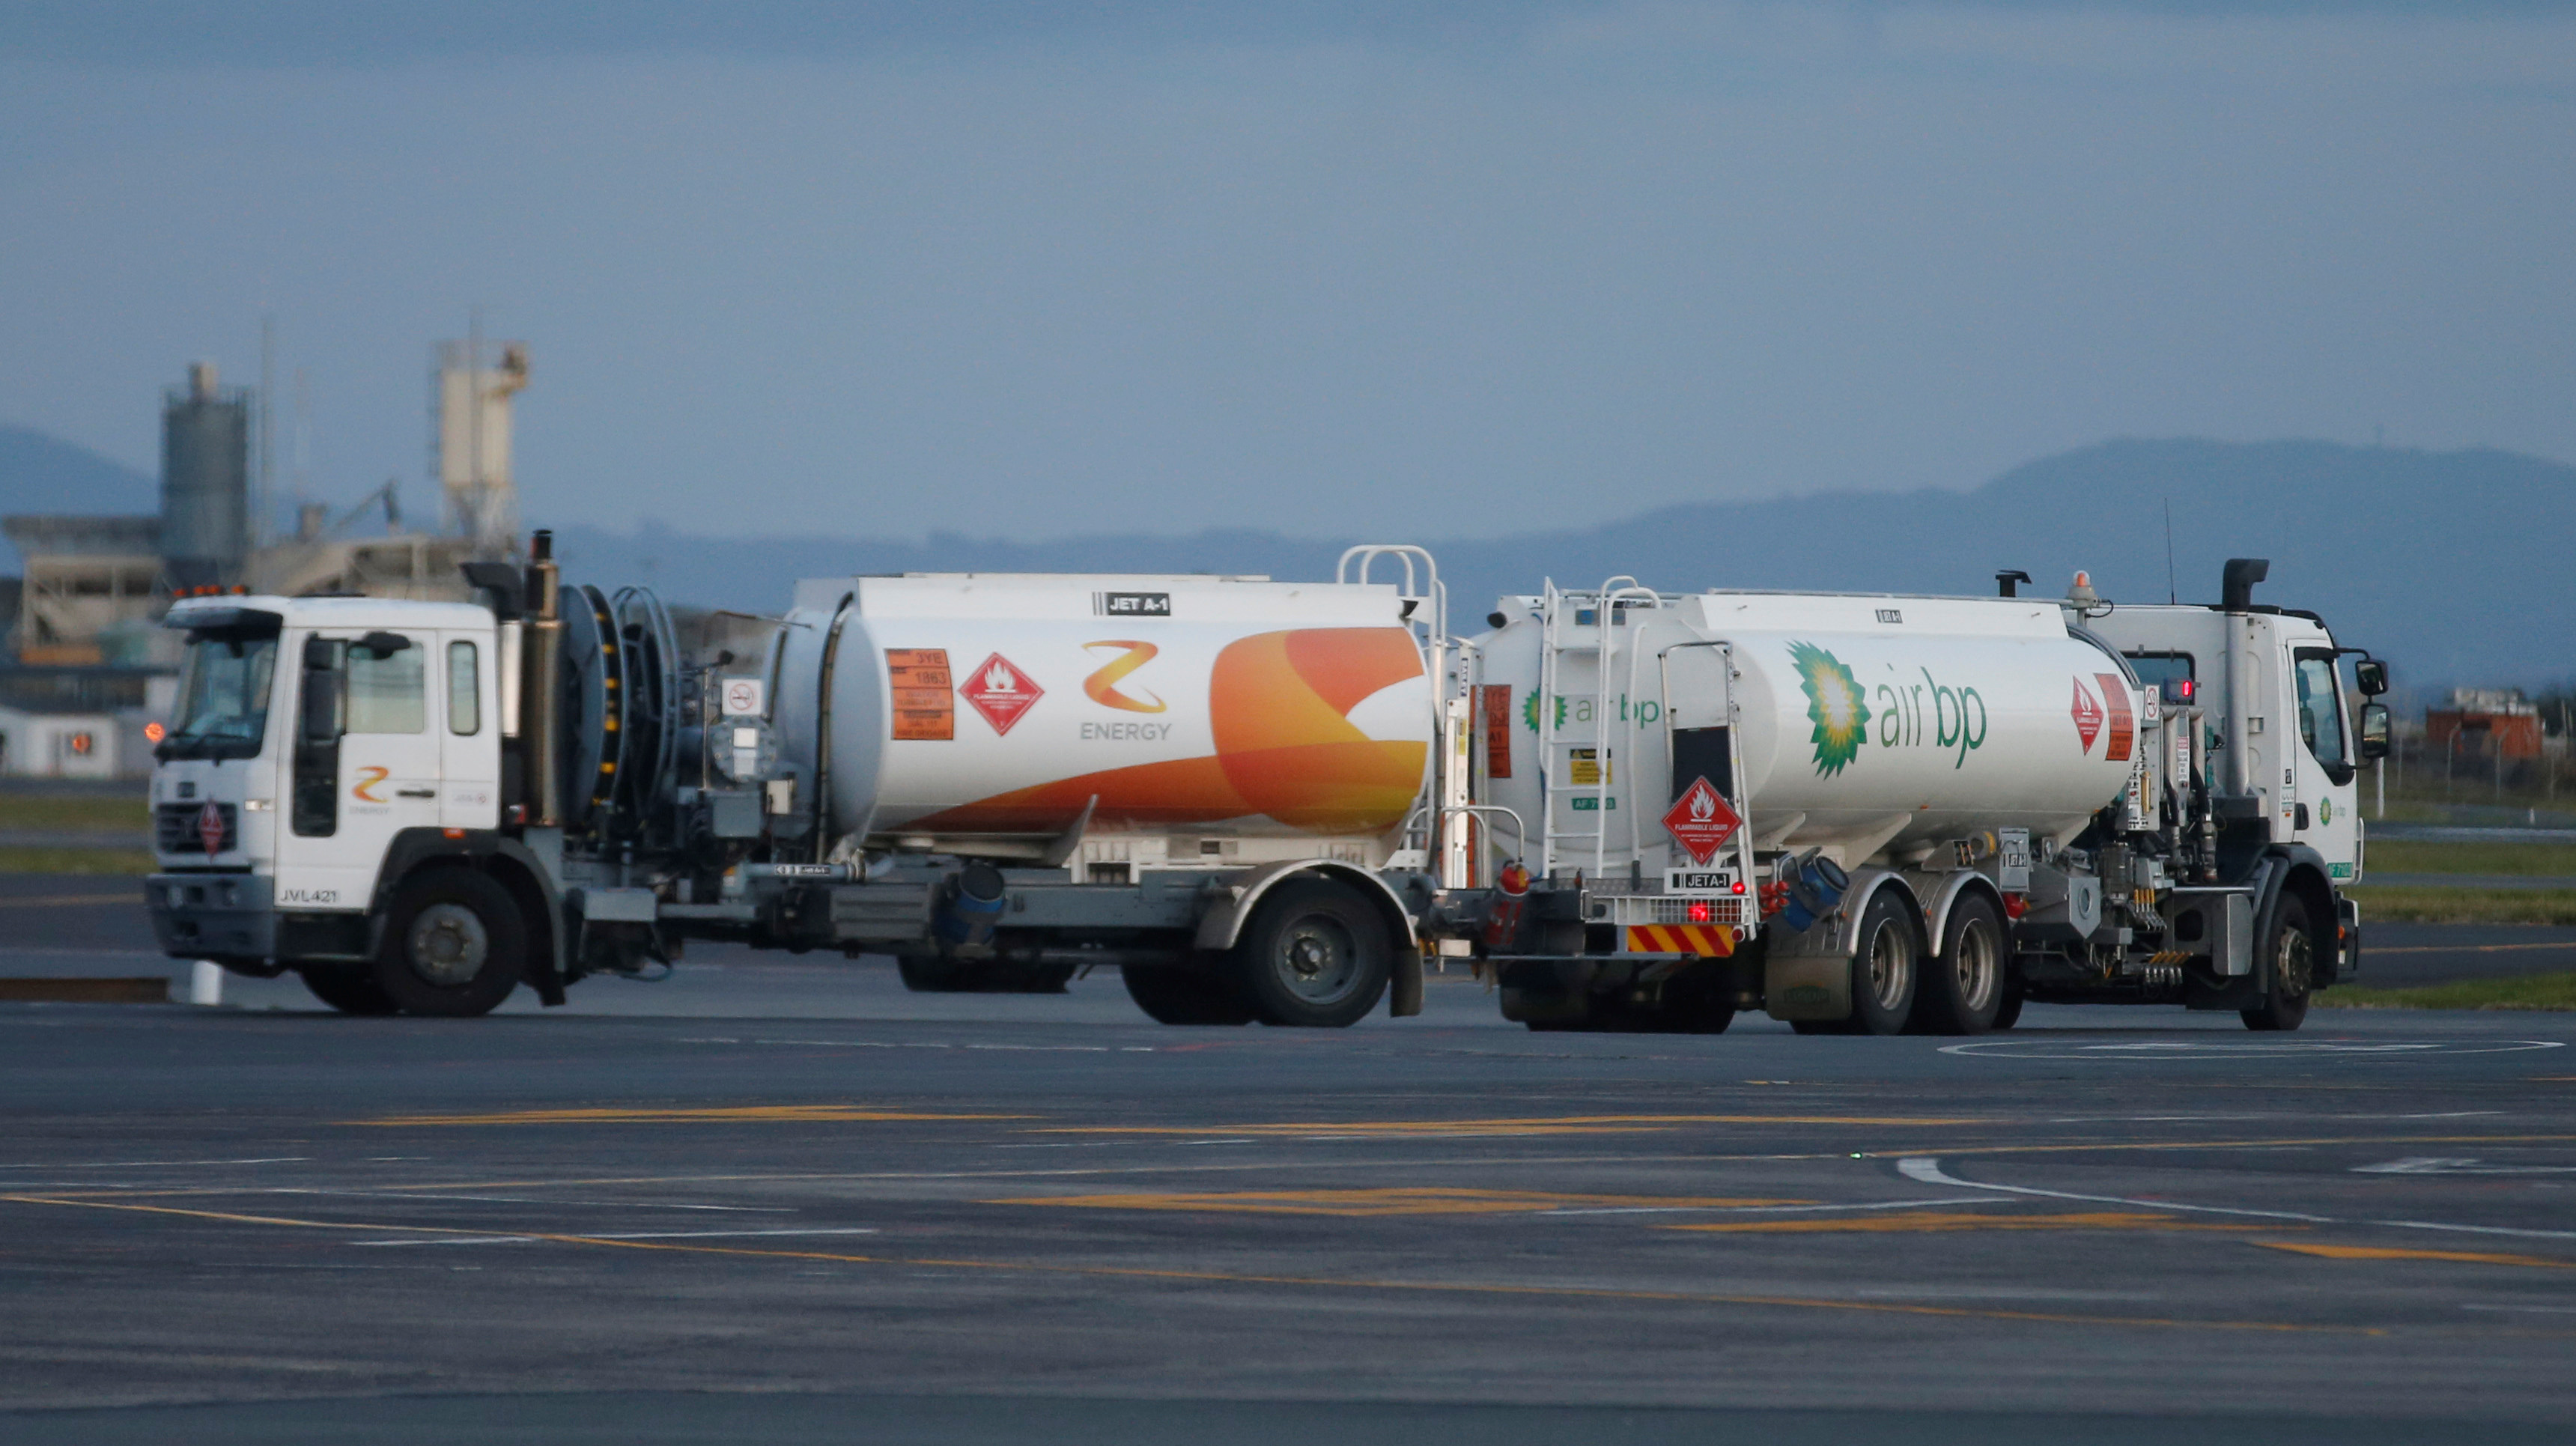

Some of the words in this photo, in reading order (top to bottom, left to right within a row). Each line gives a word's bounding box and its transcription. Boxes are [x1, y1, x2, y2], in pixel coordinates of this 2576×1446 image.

[1110, 598, 1140, 610] JET
[1143, 598, 1168, 610] A-1
[917, 653, 942, 664] 3YE
[916, 672, 947, 684] 1863
[1877, 663, 1922, 747] air
[1920, 666, 1987, 769] bp
[1080, 722, 1172, 741] ENERGY
[349, 806, 389, 815] ENERGY
